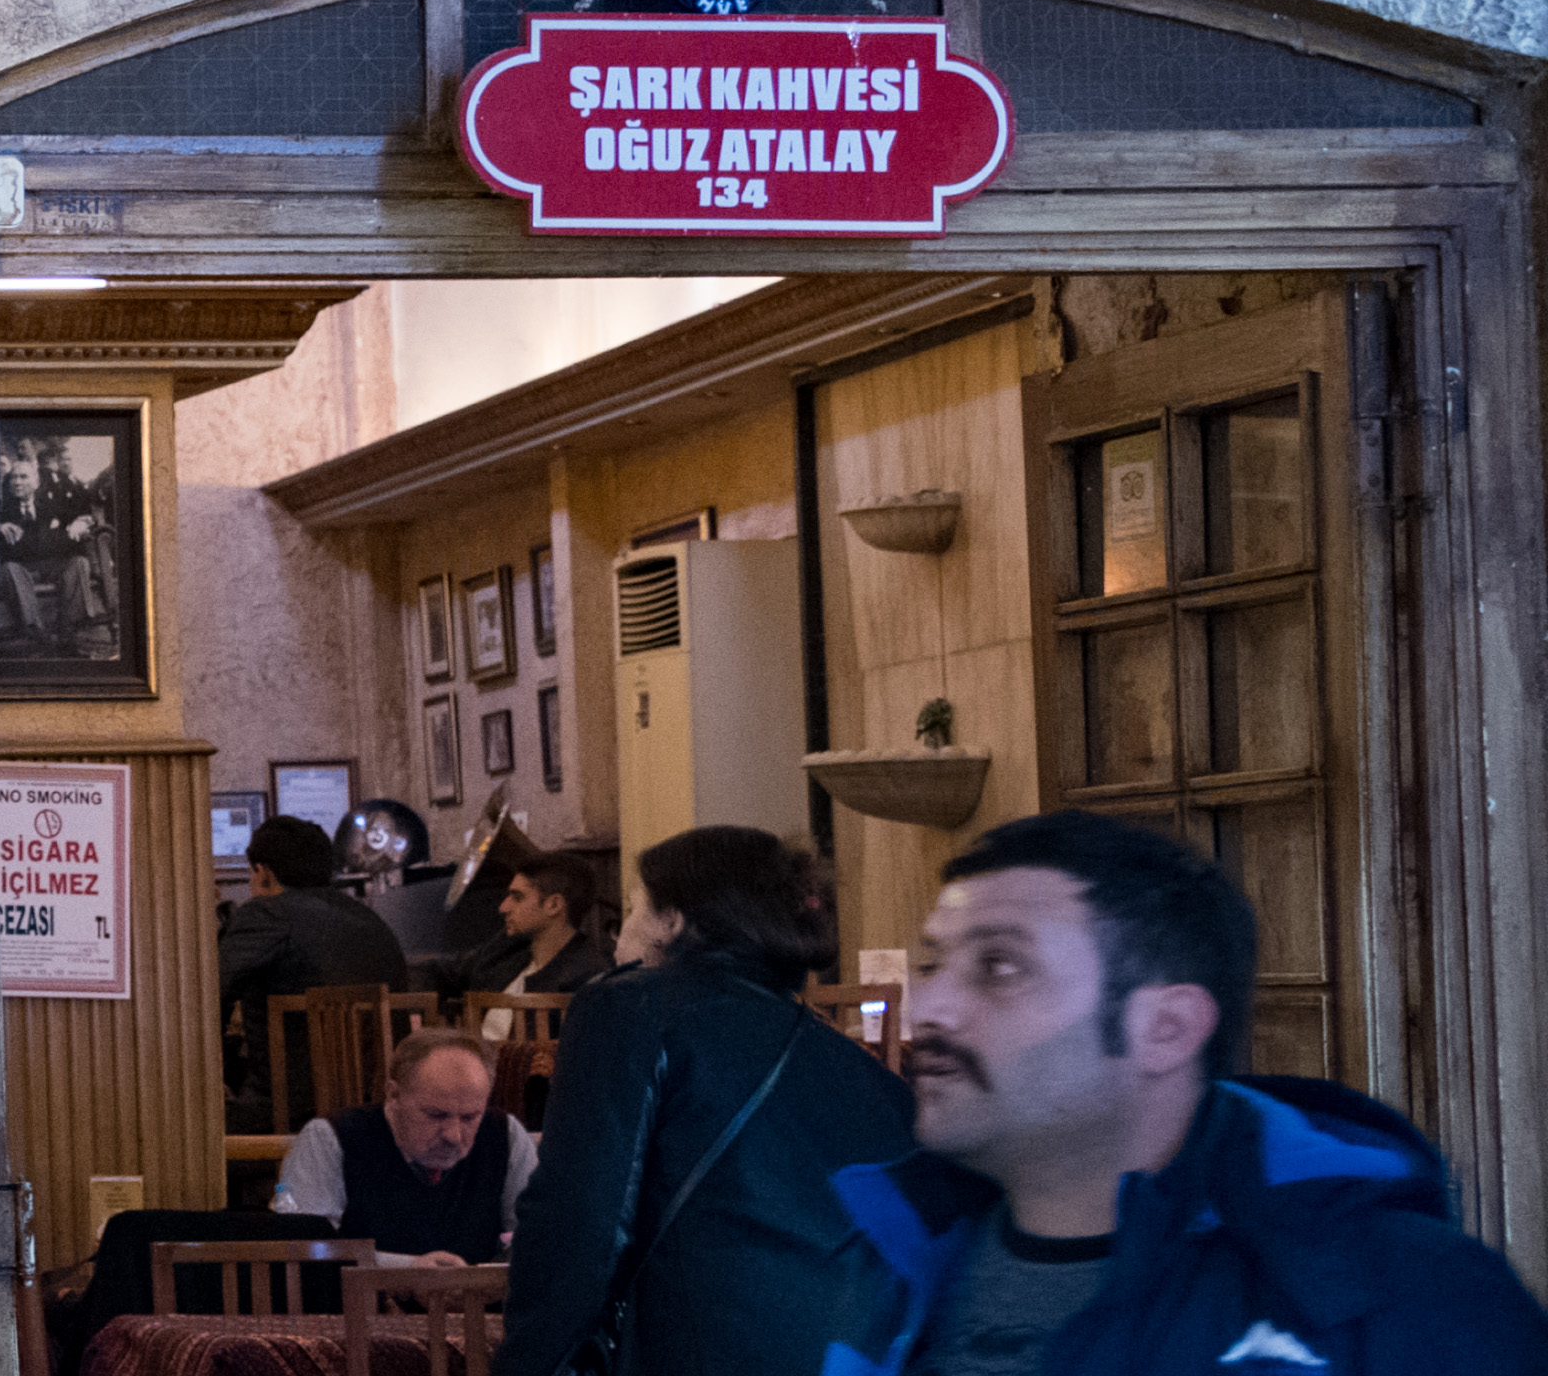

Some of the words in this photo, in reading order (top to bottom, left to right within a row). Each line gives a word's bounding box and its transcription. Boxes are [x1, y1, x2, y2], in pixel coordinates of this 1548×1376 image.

[569, 64, 700, 117] ŞARK
[710, 58, 920, 112] KAHVESİ
[583, 118, 710, 173] OĞUZ
[717, 128, 897, 173] ATALAY
[696, 176, 768, 209] 134
[0, 789, 22, 803] NO
[27, 788, 102, 805] SMOKİNG
[0, 834, 99, 863] SİGARA
[1, 866, 99, 899] İÇİLMEZ
[95, 916, 110, 939] TL
